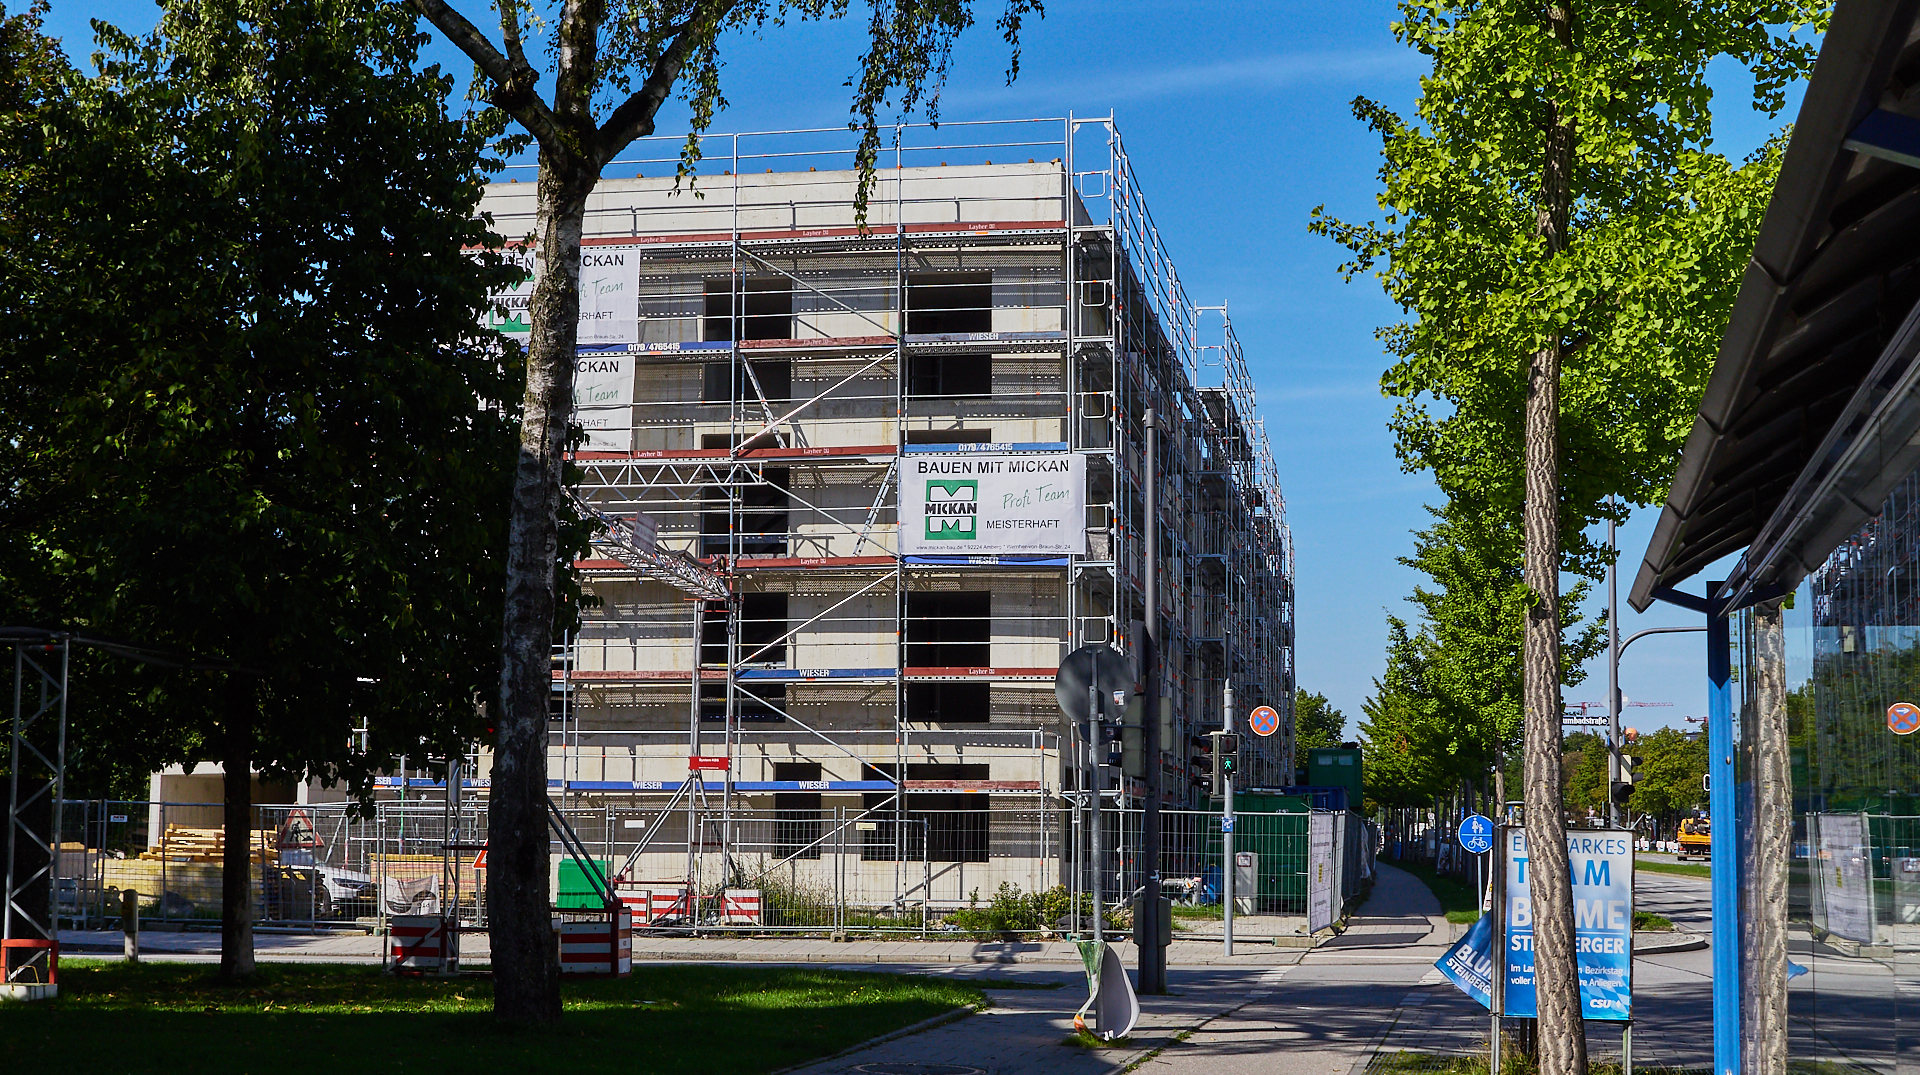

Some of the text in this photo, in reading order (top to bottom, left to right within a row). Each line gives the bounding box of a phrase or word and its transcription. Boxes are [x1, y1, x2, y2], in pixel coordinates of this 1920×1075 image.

[592, 277, 624, 295] Team
[968, 332, 999, 340] WIESER
[628, 343, 680, 351] 0179/4765415
[586, 384, 618, 402] Team
[918, 460, 1069, 474] BAUEN MIT MICKAN
[1002, 484, 1070, 509] Profi Team
[925, 502, 977, 514] MICKAN
[986, 519, 1060, 529] MEISTERHAFT
[800, 669, 830, 677] WIESER
[470, 779, 491, 787] WIES
[632, 781, 663, 789] WIESER
[798, 781, 829, 789] WIESER
[1567, 838, 1626, 854] ARKES
[1512, 897, 1625, 930] BME
[1510, 964, 1520, 972] Im
[1585, 966, 1624, 976] Bezirkstag
[1510, 976, 1531, 985] voller
[1589, 978, 1623, 988] Anliegen.
[1590, 998, 1612, 1008] CSU
